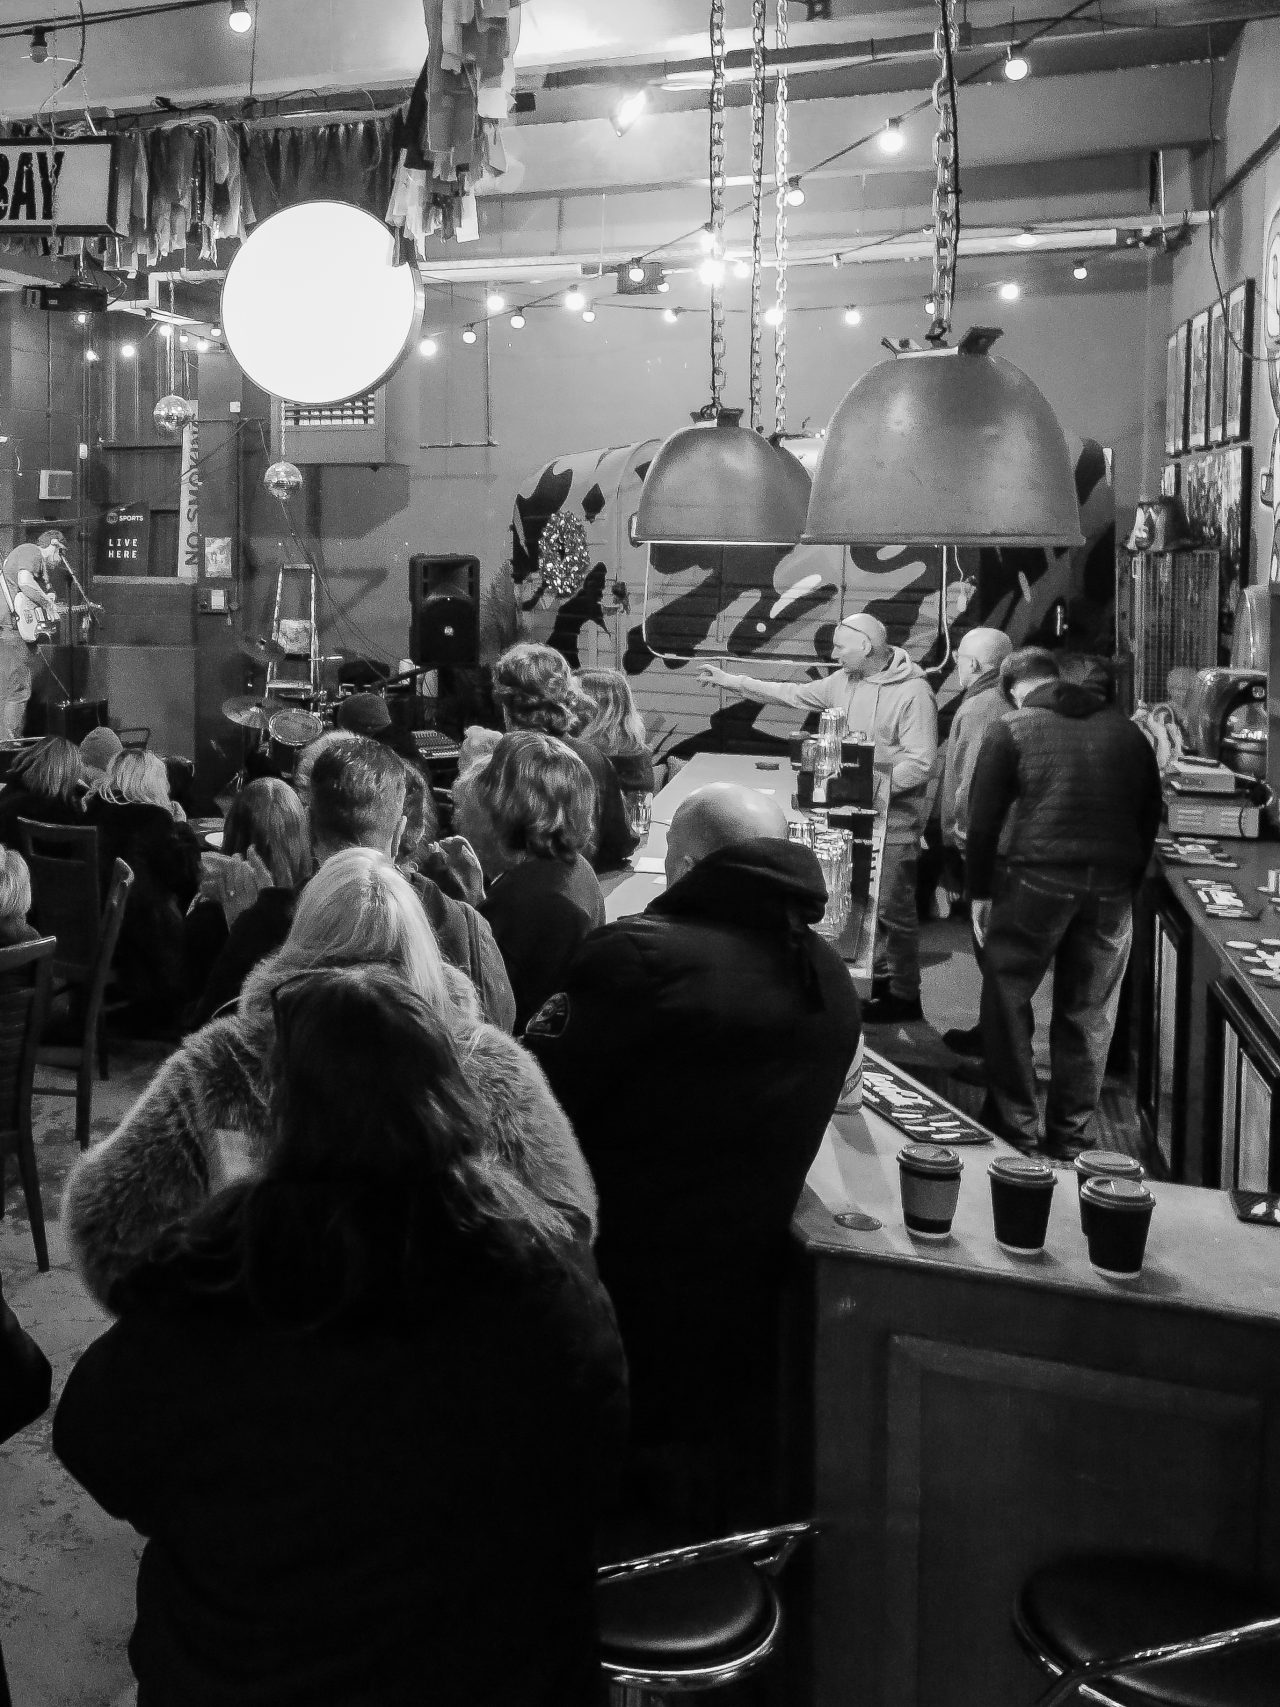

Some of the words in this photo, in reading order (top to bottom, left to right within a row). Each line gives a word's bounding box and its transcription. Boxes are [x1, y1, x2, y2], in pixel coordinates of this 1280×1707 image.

[108, 538, 138, 547] LIVE
[185, 531, 200, 565] NO
[108, 550, 138, 559] HERE
